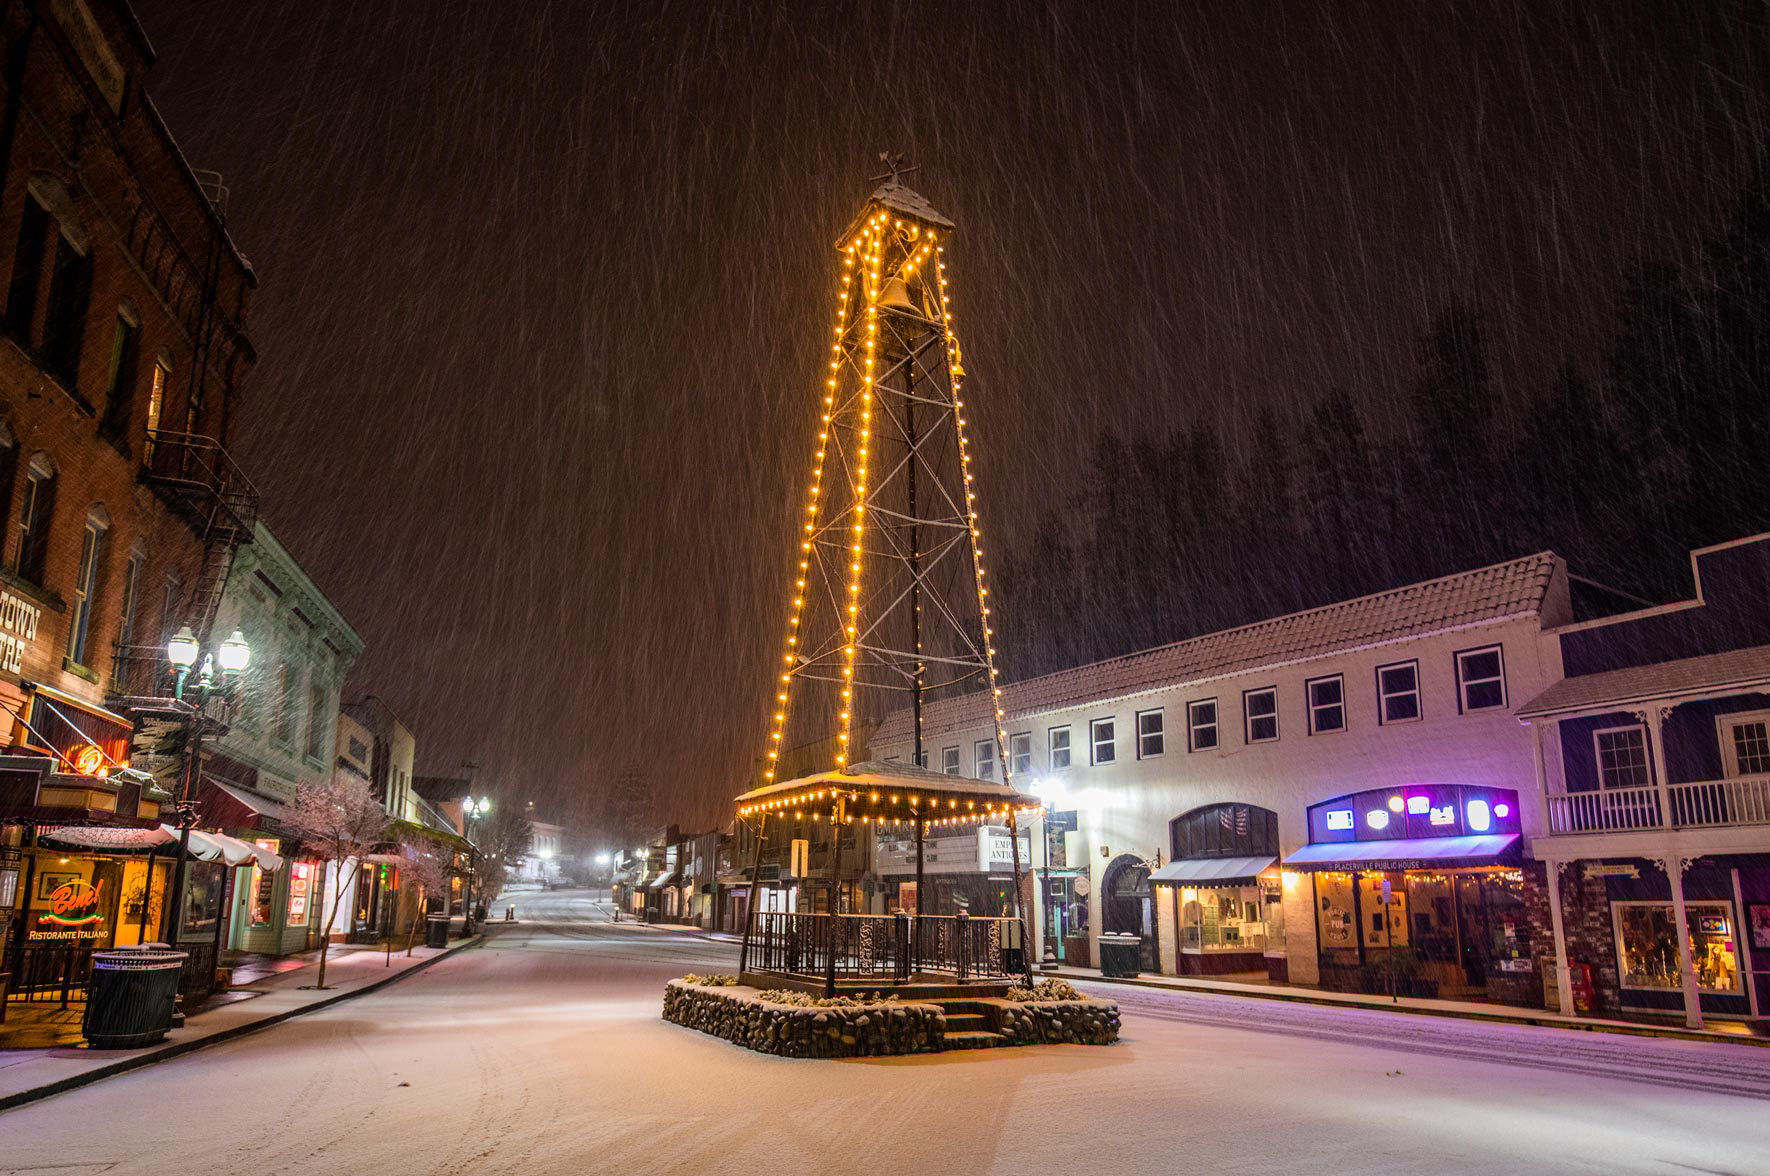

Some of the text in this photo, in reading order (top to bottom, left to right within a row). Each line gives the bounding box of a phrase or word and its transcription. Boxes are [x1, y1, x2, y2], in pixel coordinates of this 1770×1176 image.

[995, 839, 1023, 849] EMPE
[991, 850, 1028, 860] ANTIQES
[1334, 861, 1420, 871] PLACERVILLE PUBLIC HOUSE
[53, 878, 104, 915] Bene!
[1331, 920, 1344, 929] PUB
[29, 930, 109, 941] RISTORANTE ITALIANO
